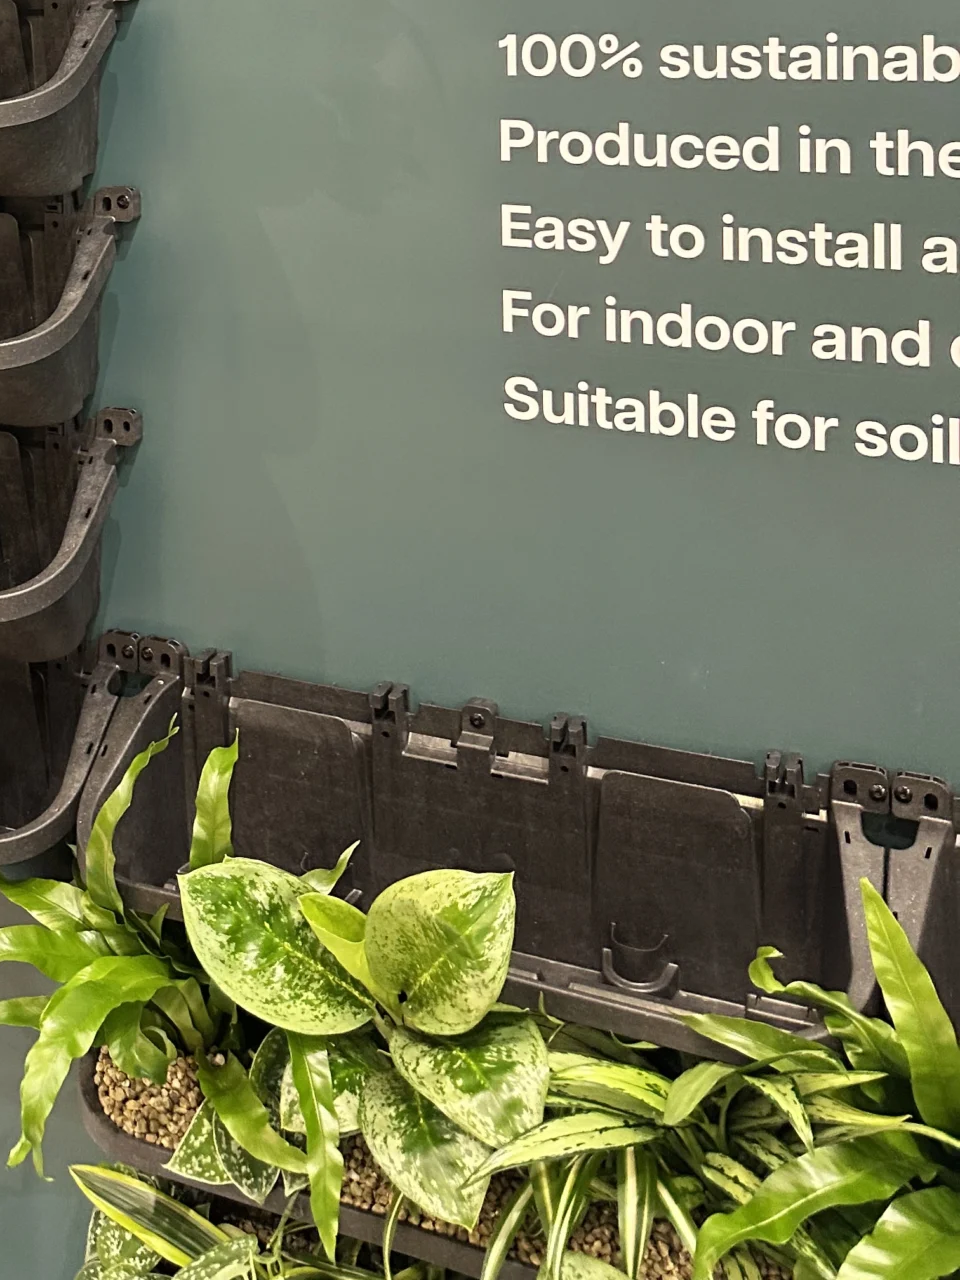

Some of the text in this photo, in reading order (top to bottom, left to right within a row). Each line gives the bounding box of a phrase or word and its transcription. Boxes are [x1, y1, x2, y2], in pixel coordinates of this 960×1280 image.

[497, 31, 960, 83] 100% sustainab
[500, 119, 780, 172] Produced
[798, 124, 852, 174] in
[501, 203, 630, 265] Easy
[645, 214, 705, 259] to
[721, 213, 902, 271] install
[502, 289, 591, 339] For
[605, 295, 796, 356] indoor
[811, 319, 930, 367] and
[503, 376, 960, 465] Suitable for soil
